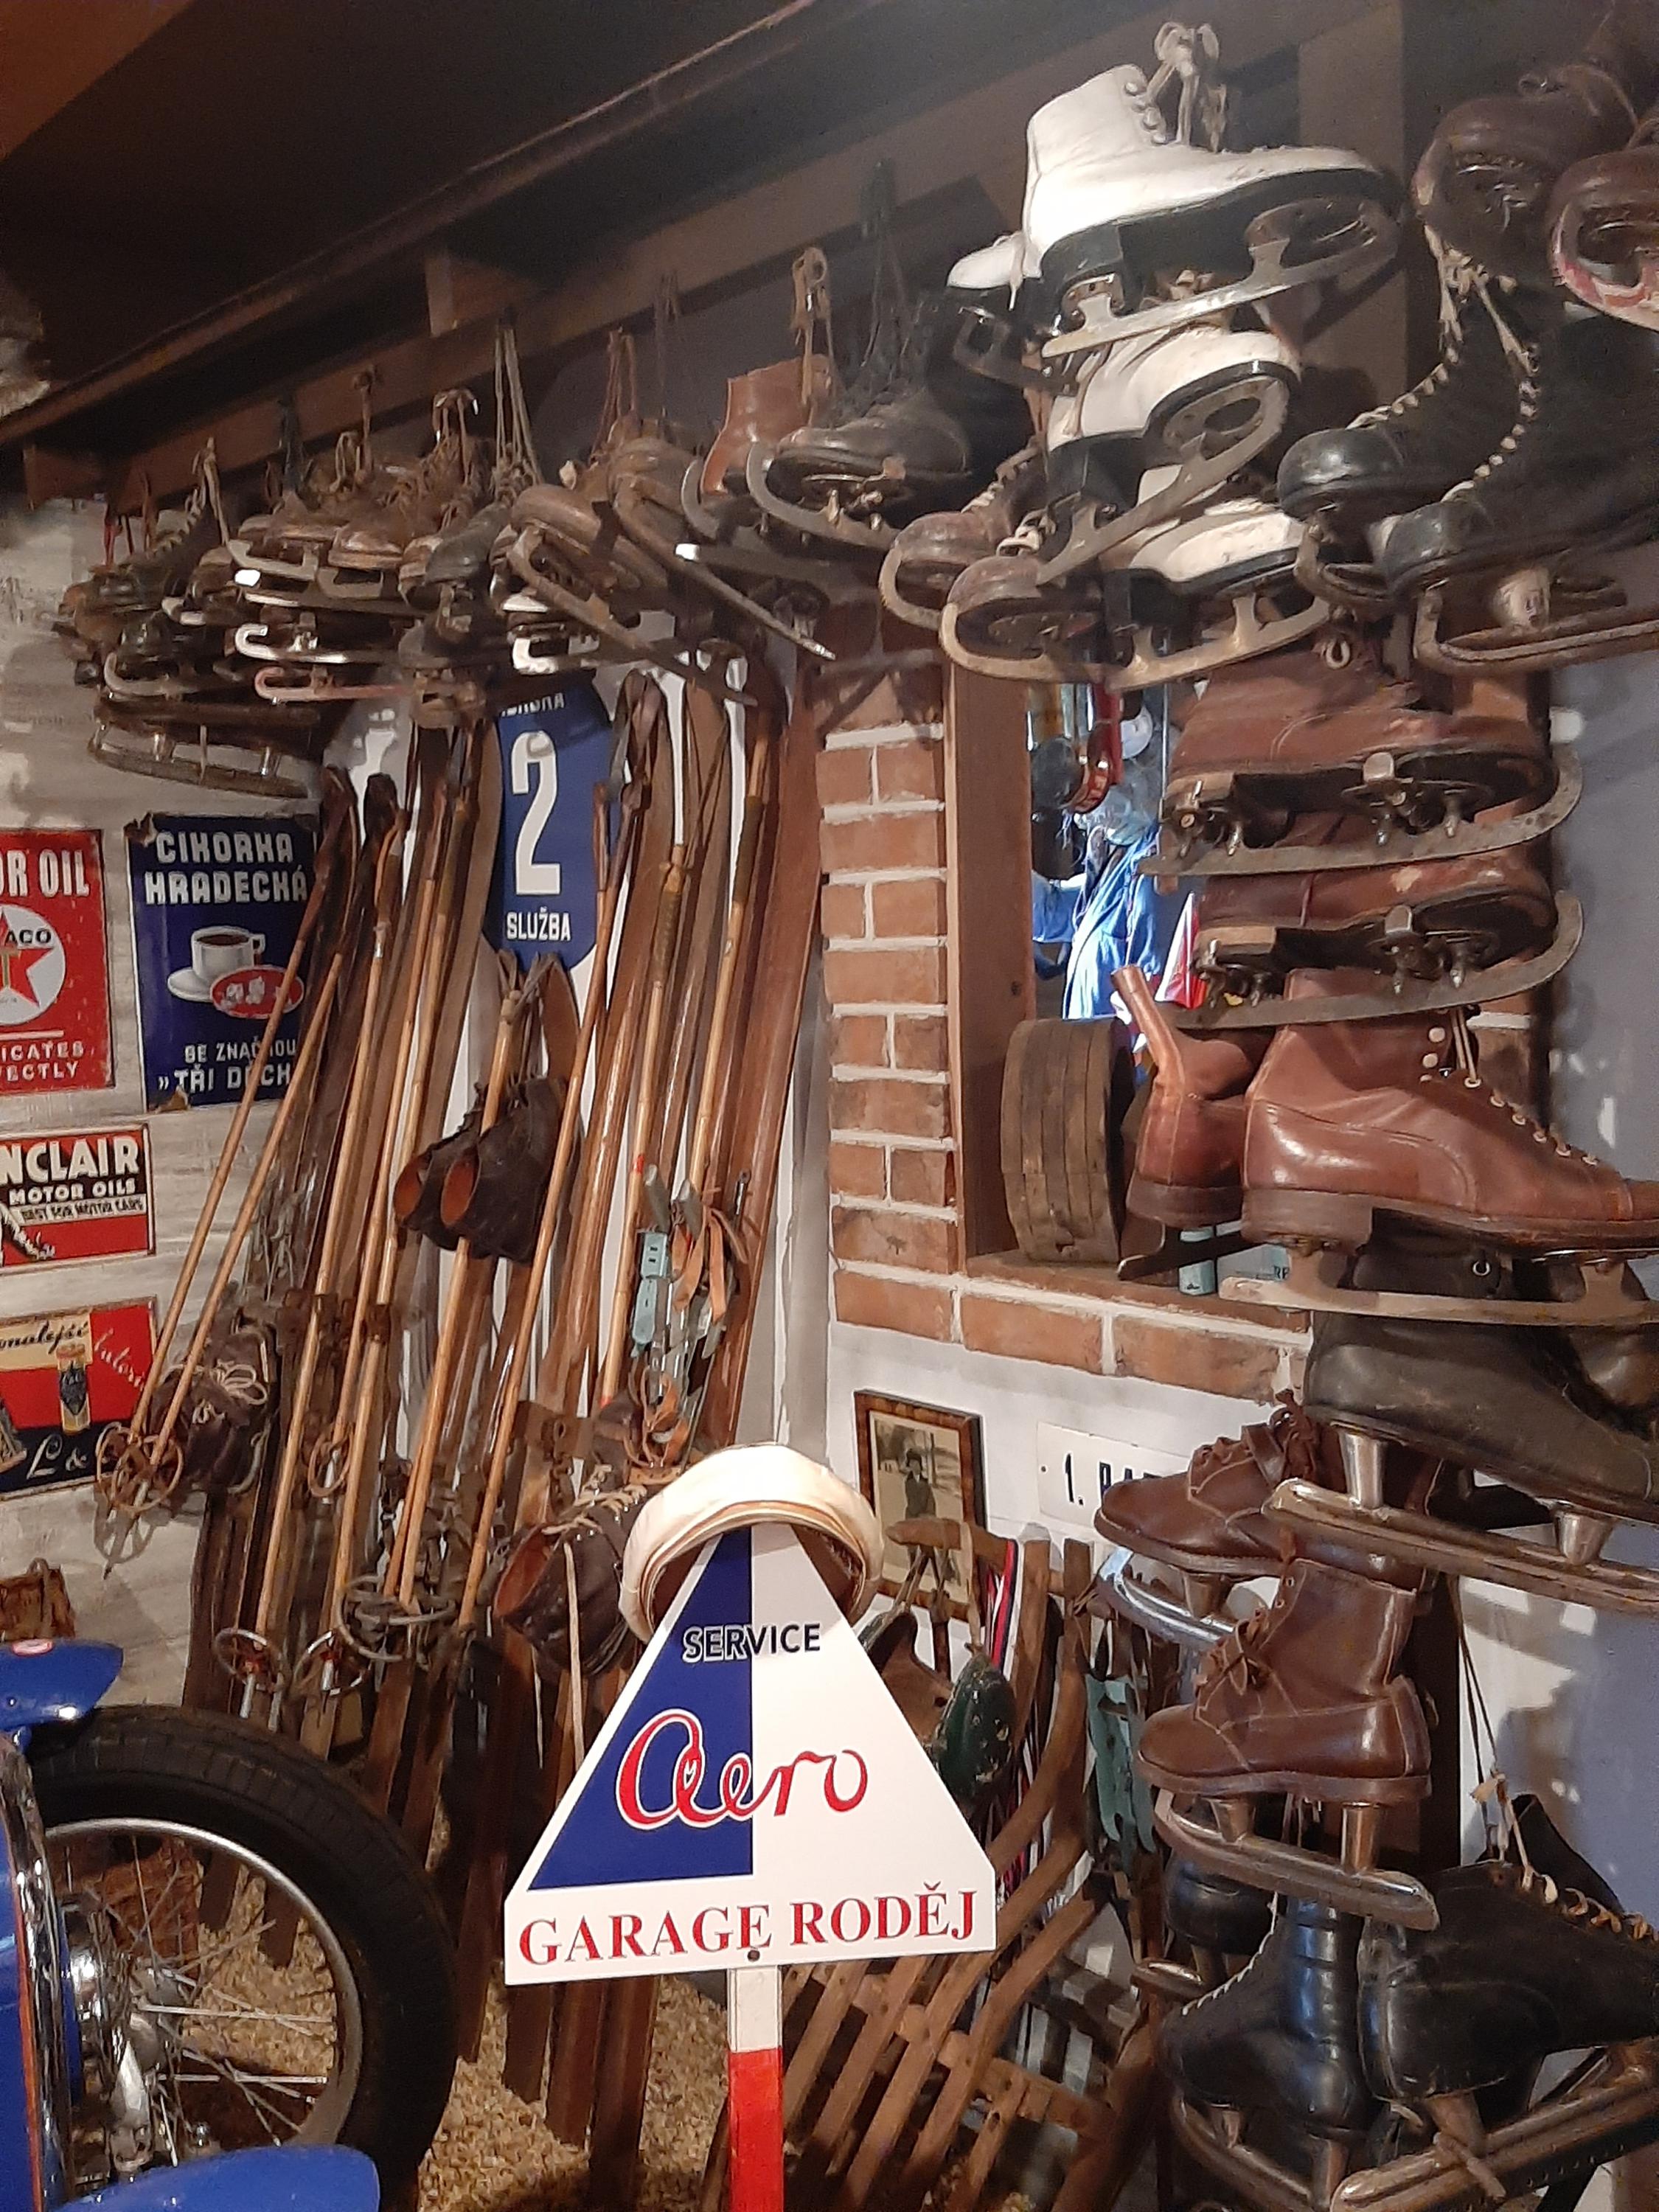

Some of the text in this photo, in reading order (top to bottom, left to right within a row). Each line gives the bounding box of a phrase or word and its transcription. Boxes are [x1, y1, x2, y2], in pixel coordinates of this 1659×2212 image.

[510, 729, 560, 895] 2
[0, 848, 89, 897] R OIL
[507, 905, 571, 942] SLUŽBA
[0, 1060, 78, 1082] ECTLY
[9, 1178, 136, 1206] MOTOR OILS
[682, 1623, 821, 1663] SERVICE
[519, 1880, 978, 1965] GARAGE RODĚJ
